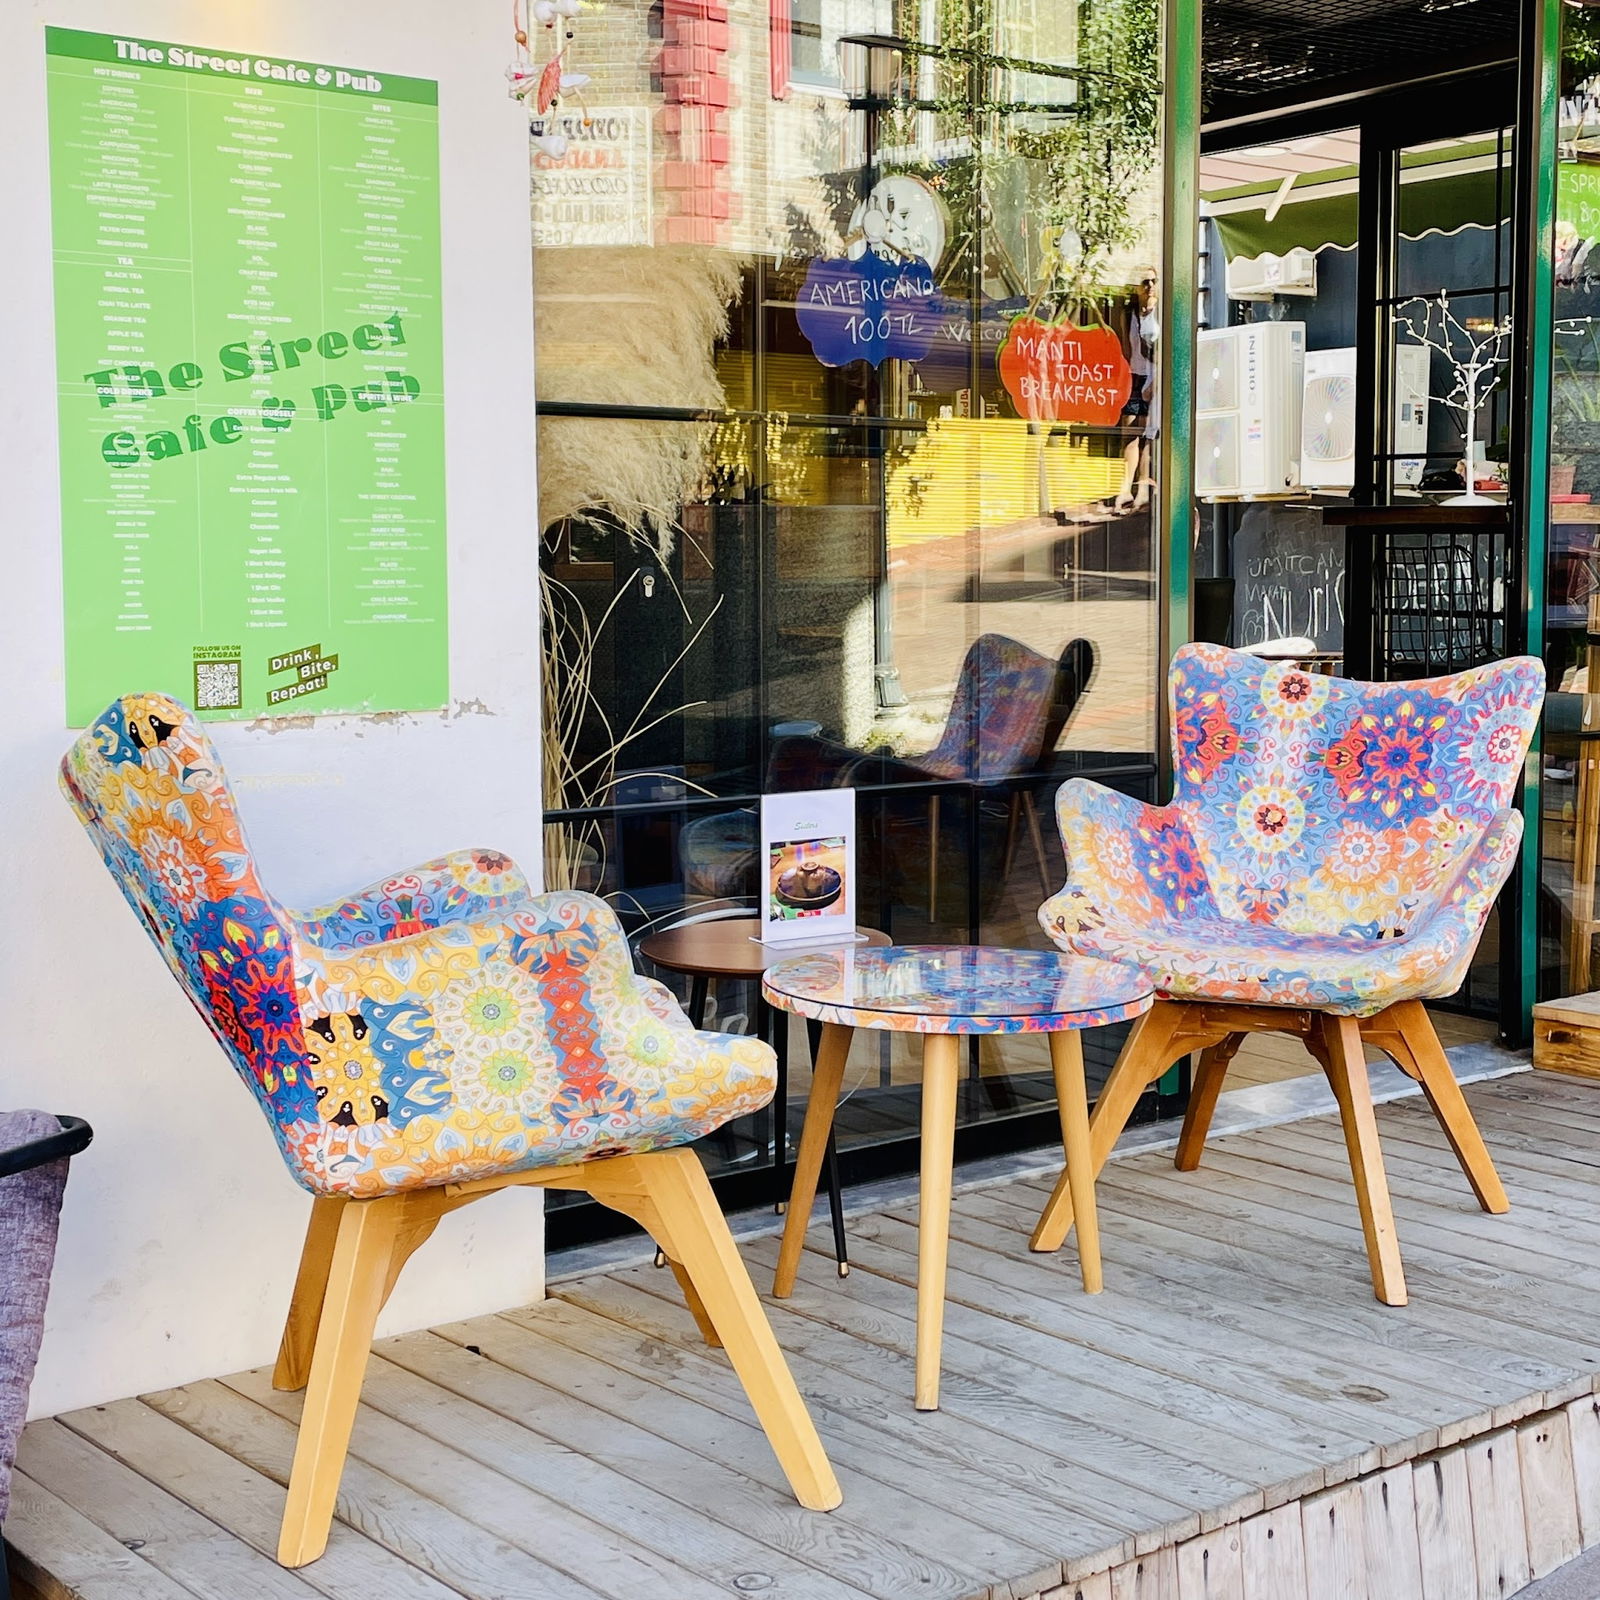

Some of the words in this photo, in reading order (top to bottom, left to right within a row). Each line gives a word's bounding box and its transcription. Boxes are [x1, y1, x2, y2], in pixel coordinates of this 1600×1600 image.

[113, 39, 163, 63] The
[168, 47, 249, 75] Street
[254, 61, 310, 83] Cafe
[313, 70, 333, 86] &
[335, 73, 384, 93] Pub
[117, 257, 133, 265] TEA
[810, 277, 935, 307] AMERICANO
[1017, 336, 1082, 362] MANTI
[83, 361, 204, 409] The
[219, 311, 407, 382] Street
[1058, 364, 1114, 383] TOAST
[97, 387, 120, 395] COLD
[121, 388, 153, 396] DRINKS
[393, 394, 413, 402] WINE
[1020, 376, 1118, 406] BREAKFAST
[227, 408, 257, 416] COFFEE
[257, 409, 296, 418] YOURSELF
[193, 651, 241, 659] INSTAGRAM
[301, 660, 336, 678] Bite,
[271, 676, 325, 703] Repeat!
